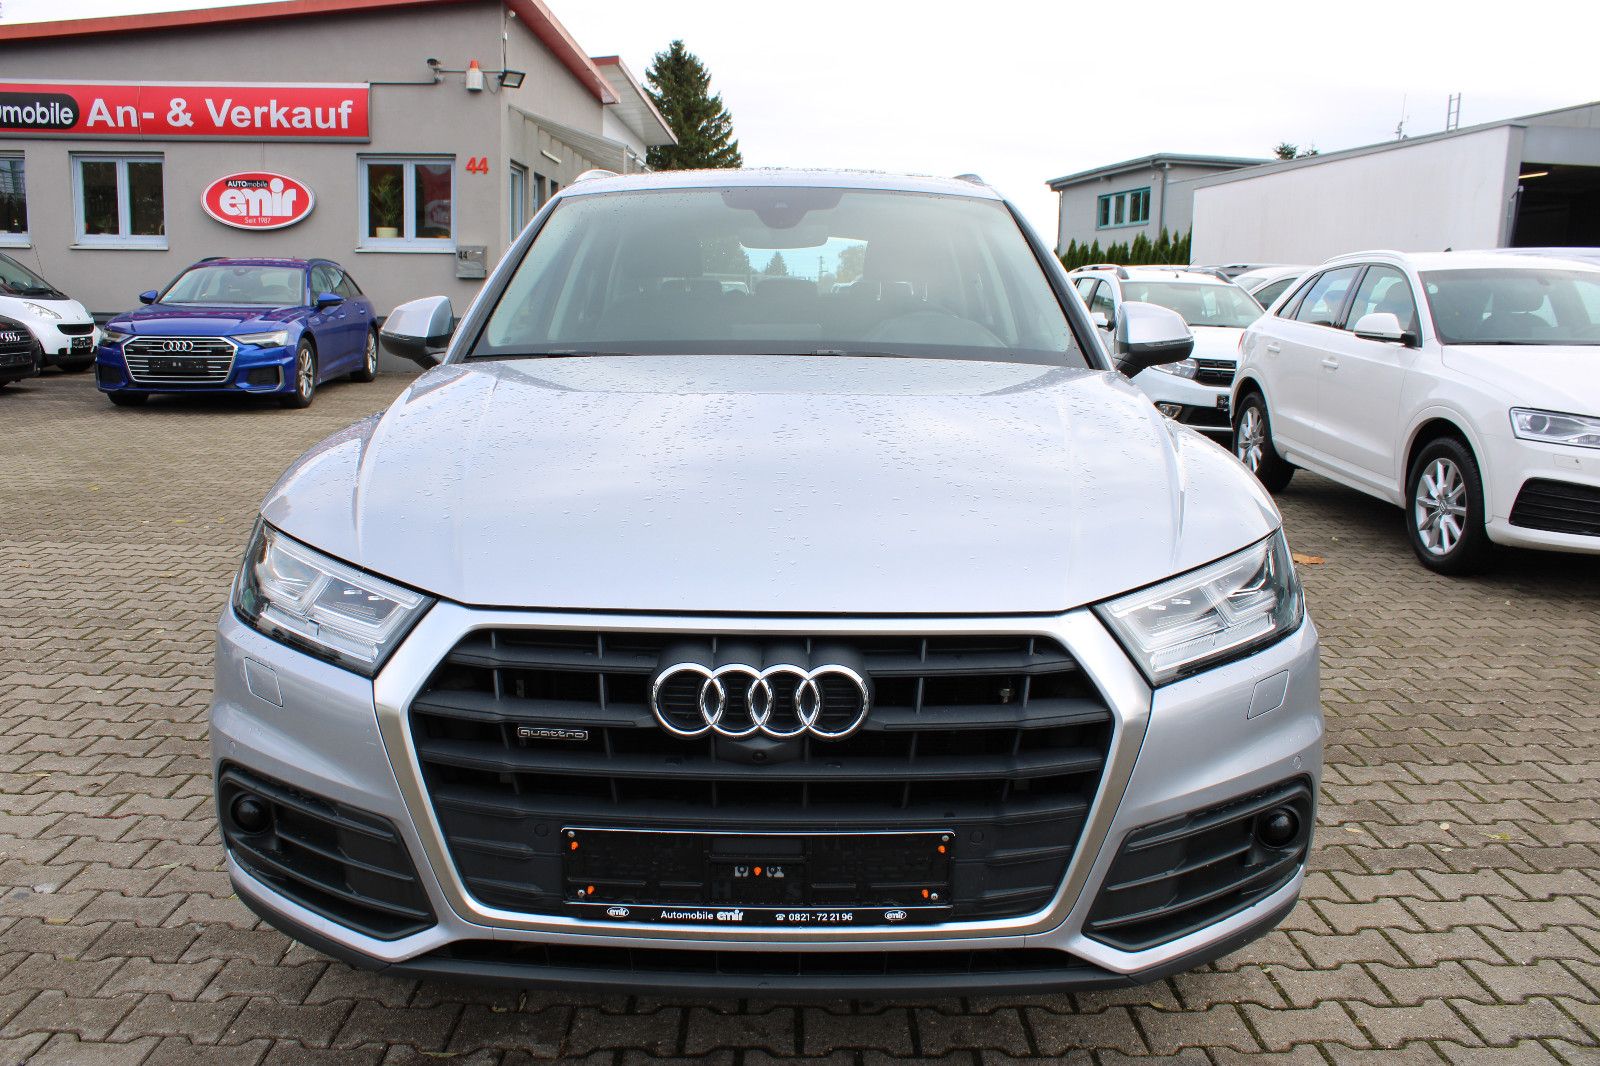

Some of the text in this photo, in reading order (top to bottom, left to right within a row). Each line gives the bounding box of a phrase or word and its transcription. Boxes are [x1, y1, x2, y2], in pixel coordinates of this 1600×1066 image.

[0, 97, 354, 129] mobile An- & Verkauf
[465, 156, 489, 175] 44
[227, 180, 268, 188] AUTOmobile
[219, 178, 297, 217] emir
[520, 729, 585, 739] quattro
[661, 910, 714, 920] Automobile
[716, 909, 744, 921] emir
[788, 913, 810, 922] 0821
[816, 913, 828, 921] 72
